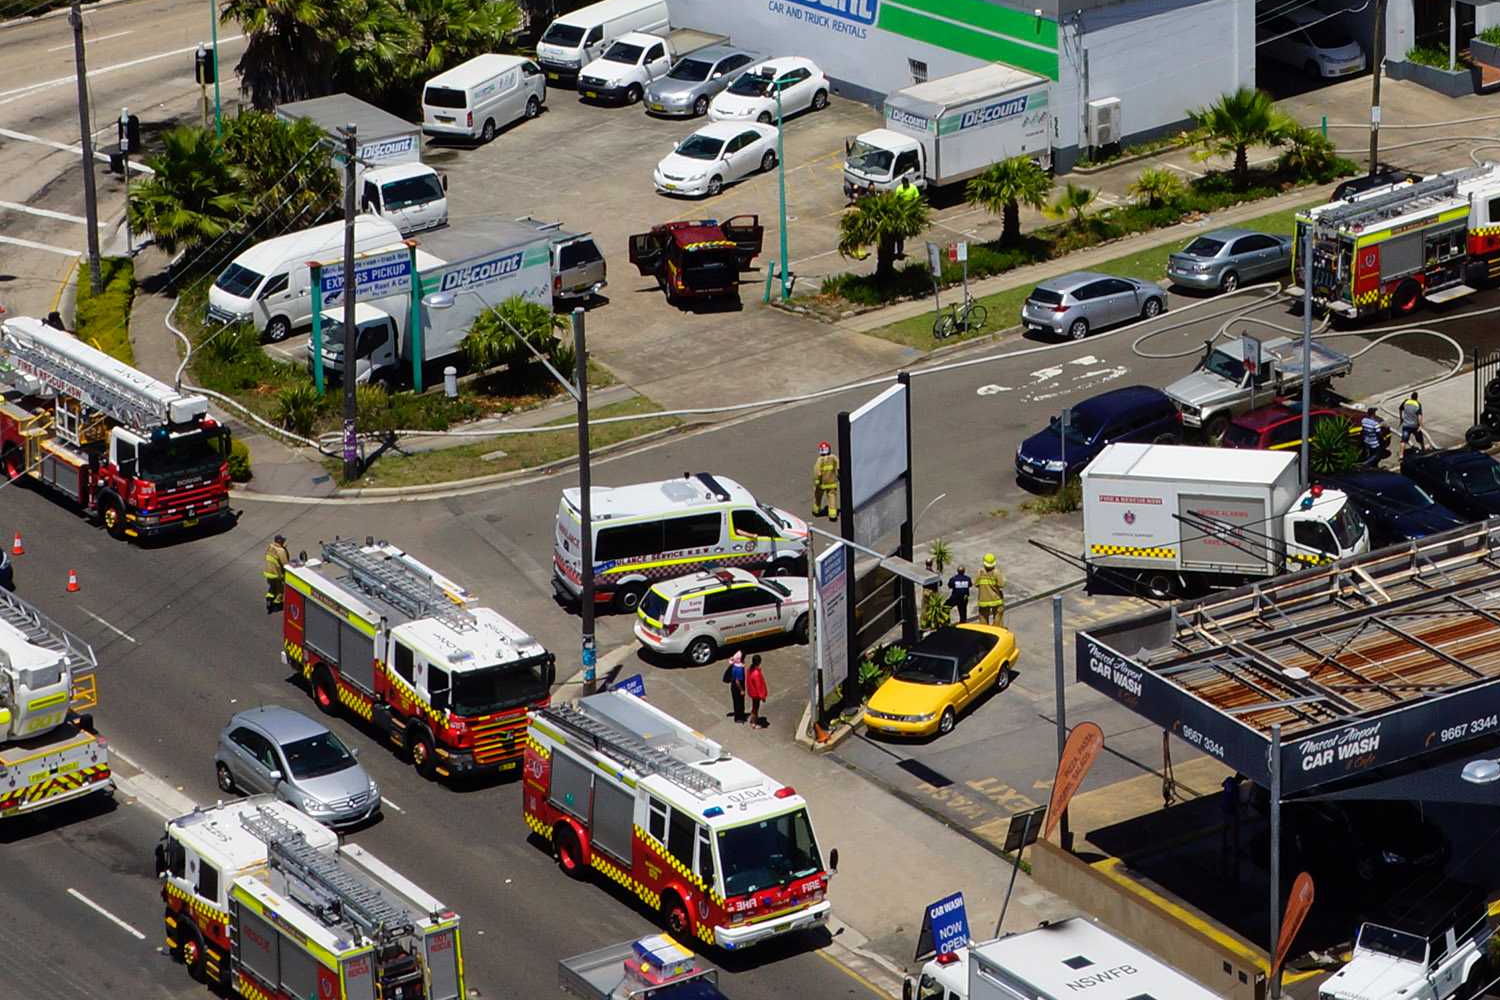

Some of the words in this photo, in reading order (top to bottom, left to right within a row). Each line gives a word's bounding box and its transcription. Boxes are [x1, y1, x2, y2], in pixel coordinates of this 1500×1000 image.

[768, 1, 785, 14] CAR
[786, 6, 802, 20] AND
[805, 10, 829, 27] TRUCK
[832, 20, 867, 40] RENTALS
[964, 98, 1025, 127] Discount
[326, 271, 368, 289] EXPSS
[371, 263, 406, 280] PICKUP
[445, 255, 520, 289] Discount
[650, 551, 684, 561] SERVICE
[1089, 659, 1111, 680] CAR
[1112, 671, 1142, 697] WASH
[1114, 659, 1143, 681] Airport
[1183, 724, 1202, 744] 9667
[1203, 737, 1225, 758] 3344
[1338, 721, 1381, 744] Airport
[1440, 723, 1467, 742] 9667
[1470, 714, 1498, 734] 3344
[1302, 750, 1333, 771] CAR
[1338, 735, 1380, 760] WASH
[802, 879, 821, 893] FIRE
[930, 906, 944, 919] CAR
[944, 897, 963, 913] WASH
[940, 920, 962, 940] NOW
[941, 934, 967, 954] OPEN
[1065, 964, 1138, 991] NSWFB
